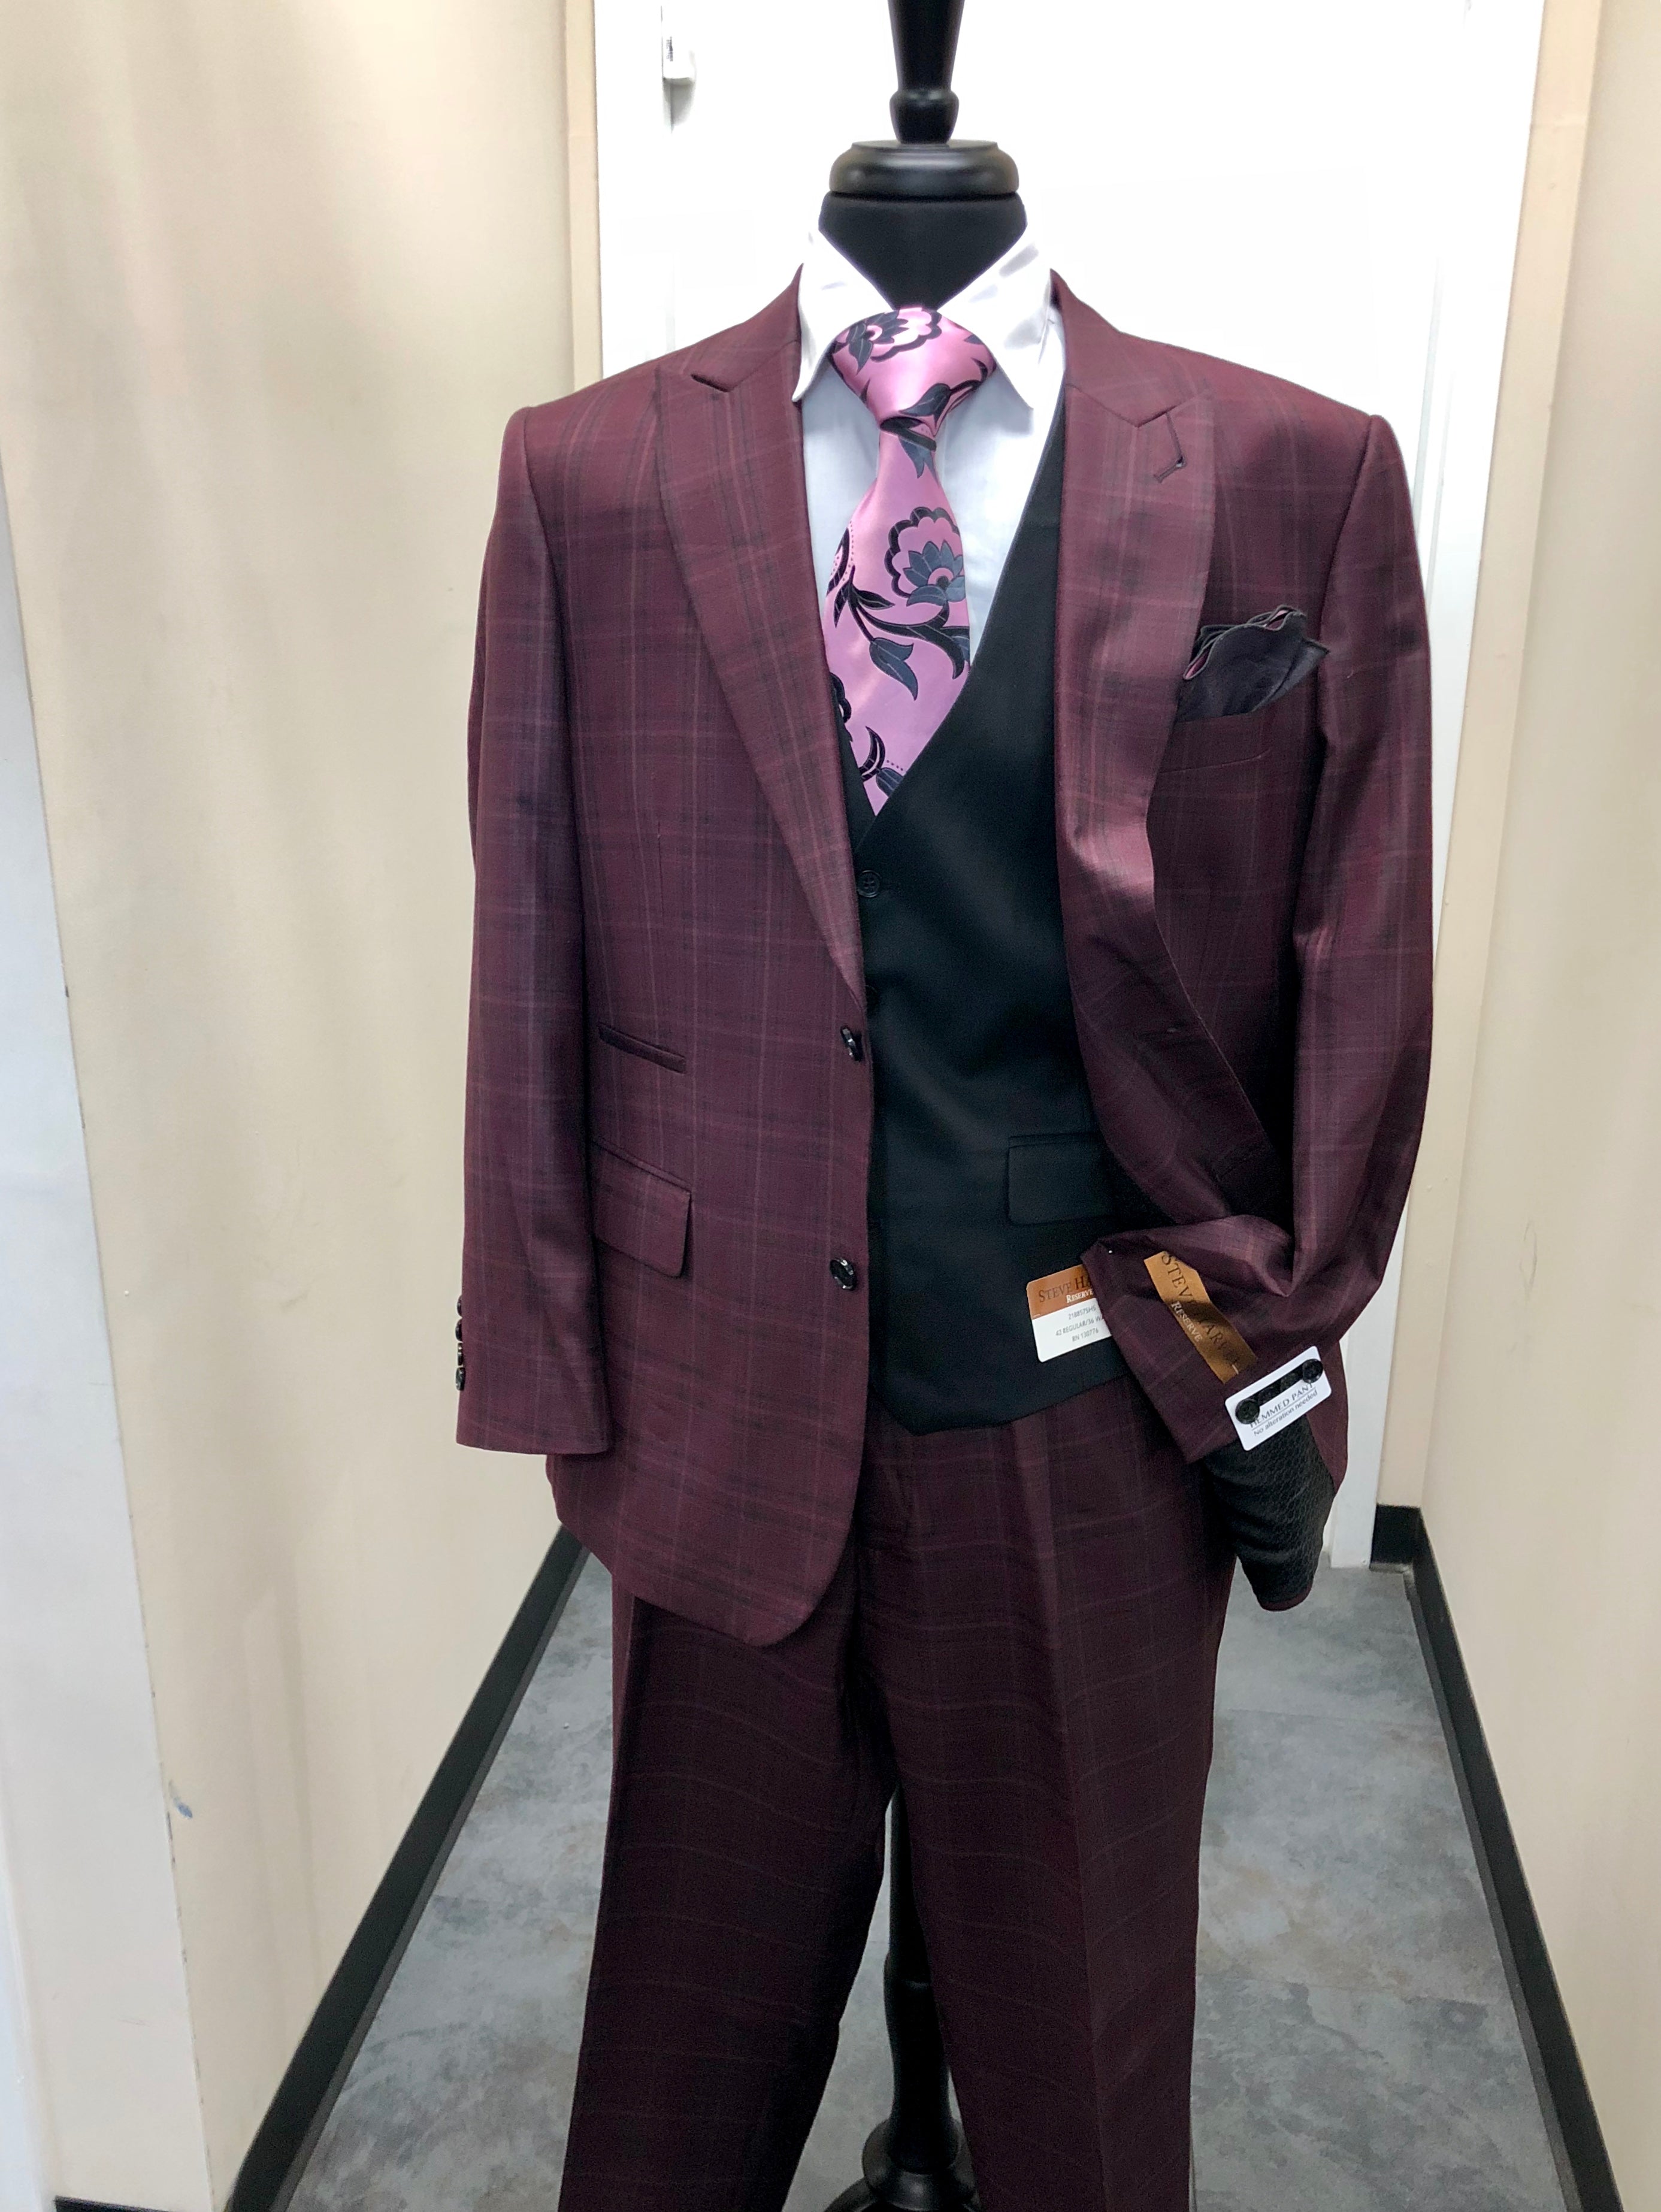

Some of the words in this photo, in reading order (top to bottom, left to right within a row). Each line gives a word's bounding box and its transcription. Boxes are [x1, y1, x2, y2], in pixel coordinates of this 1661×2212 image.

[1039, 1282, 1071, 1302] STEVE
[1066, 1288, 1094, 1303] RESERVE
[1171, 1300, 1203, 1342] RESERVE
[1072, 1333, 1080, 1342] RN
[1254, 1428, 1264, 1436] No
[1265, 1408, 1294, 1429] alteration
[1295, 1389, 1318, 1410] needed
